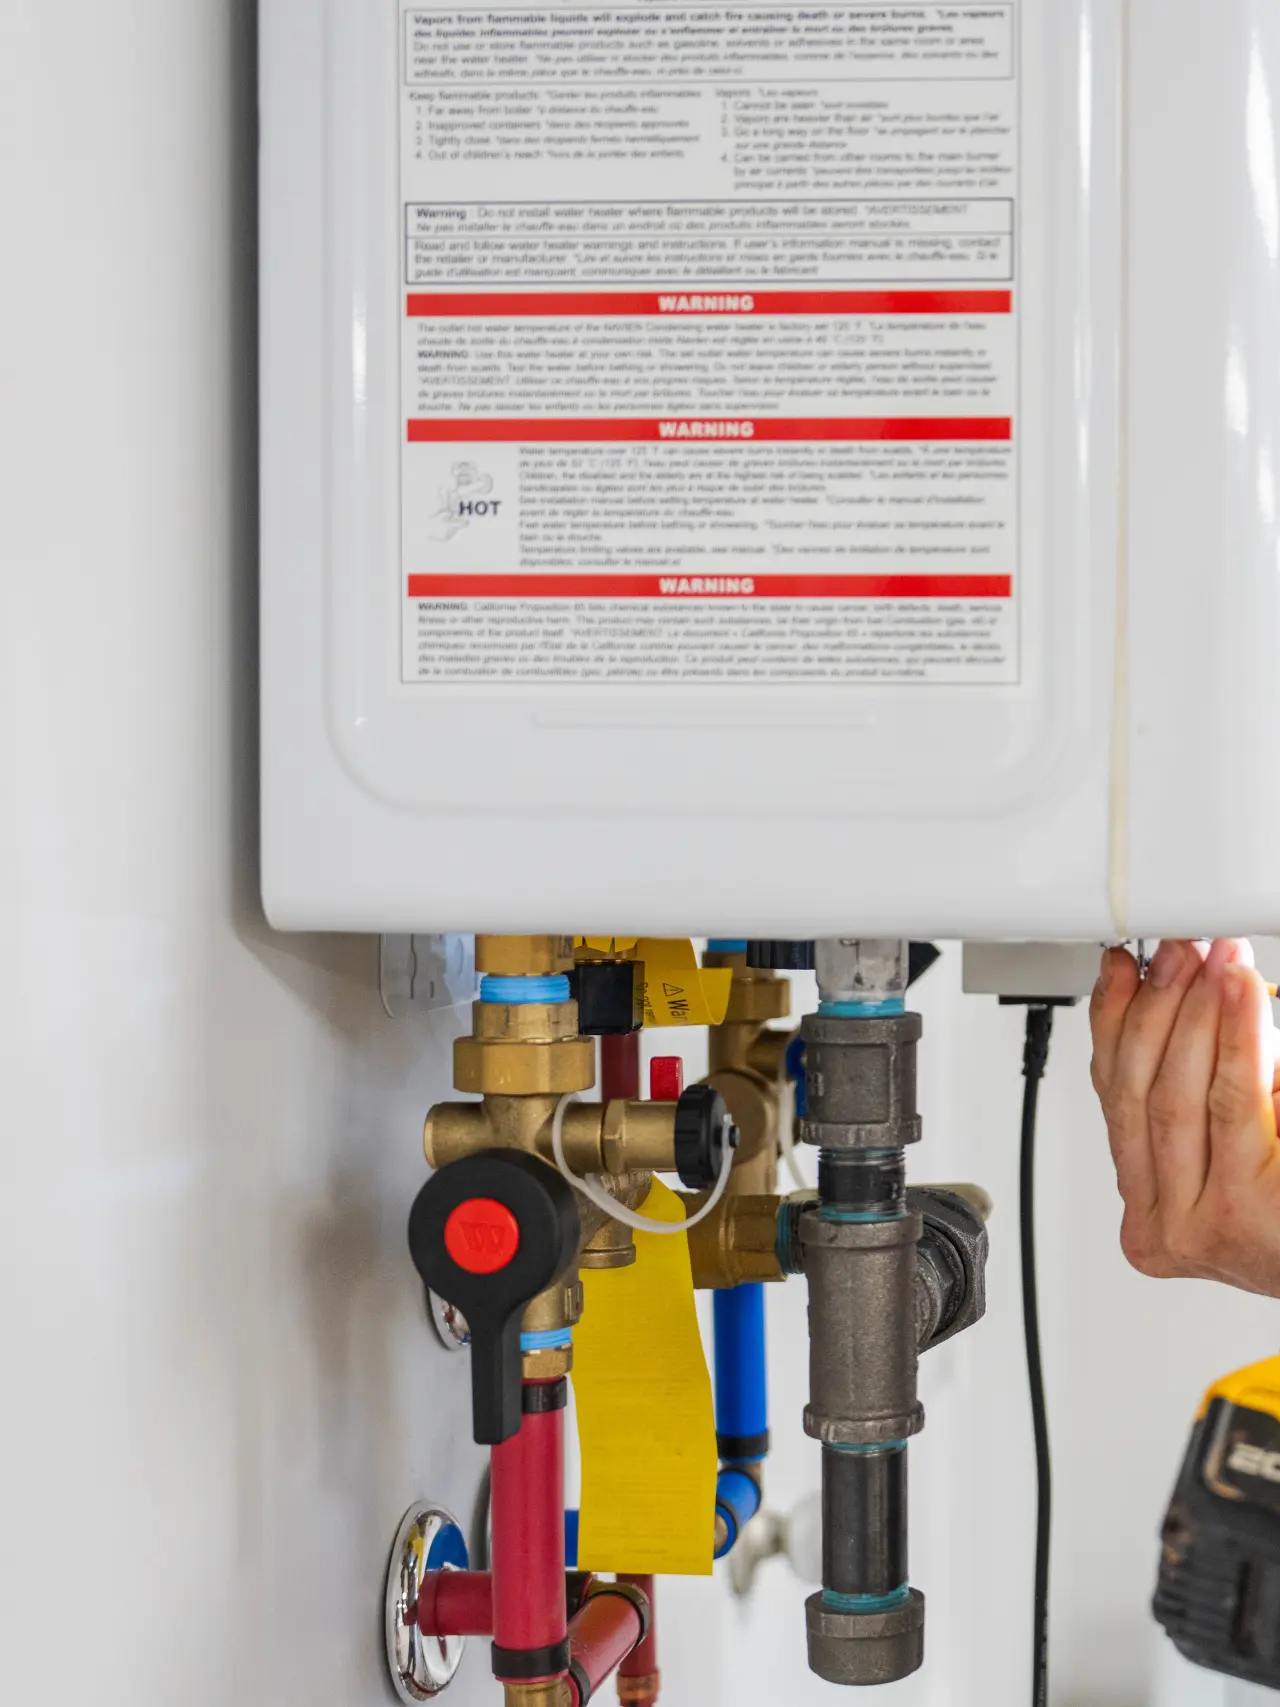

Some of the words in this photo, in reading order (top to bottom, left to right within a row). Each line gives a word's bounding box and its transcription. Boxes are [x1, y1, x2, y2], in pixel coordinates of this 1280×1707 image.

[416, 207, 467, 219] Warning
[658, 294, 755, 313] WARNING
[658, 421, 755, 438] WARNING
[458, 500, 502, 517] HOT
[658, 577, 755, 595] WARNING
